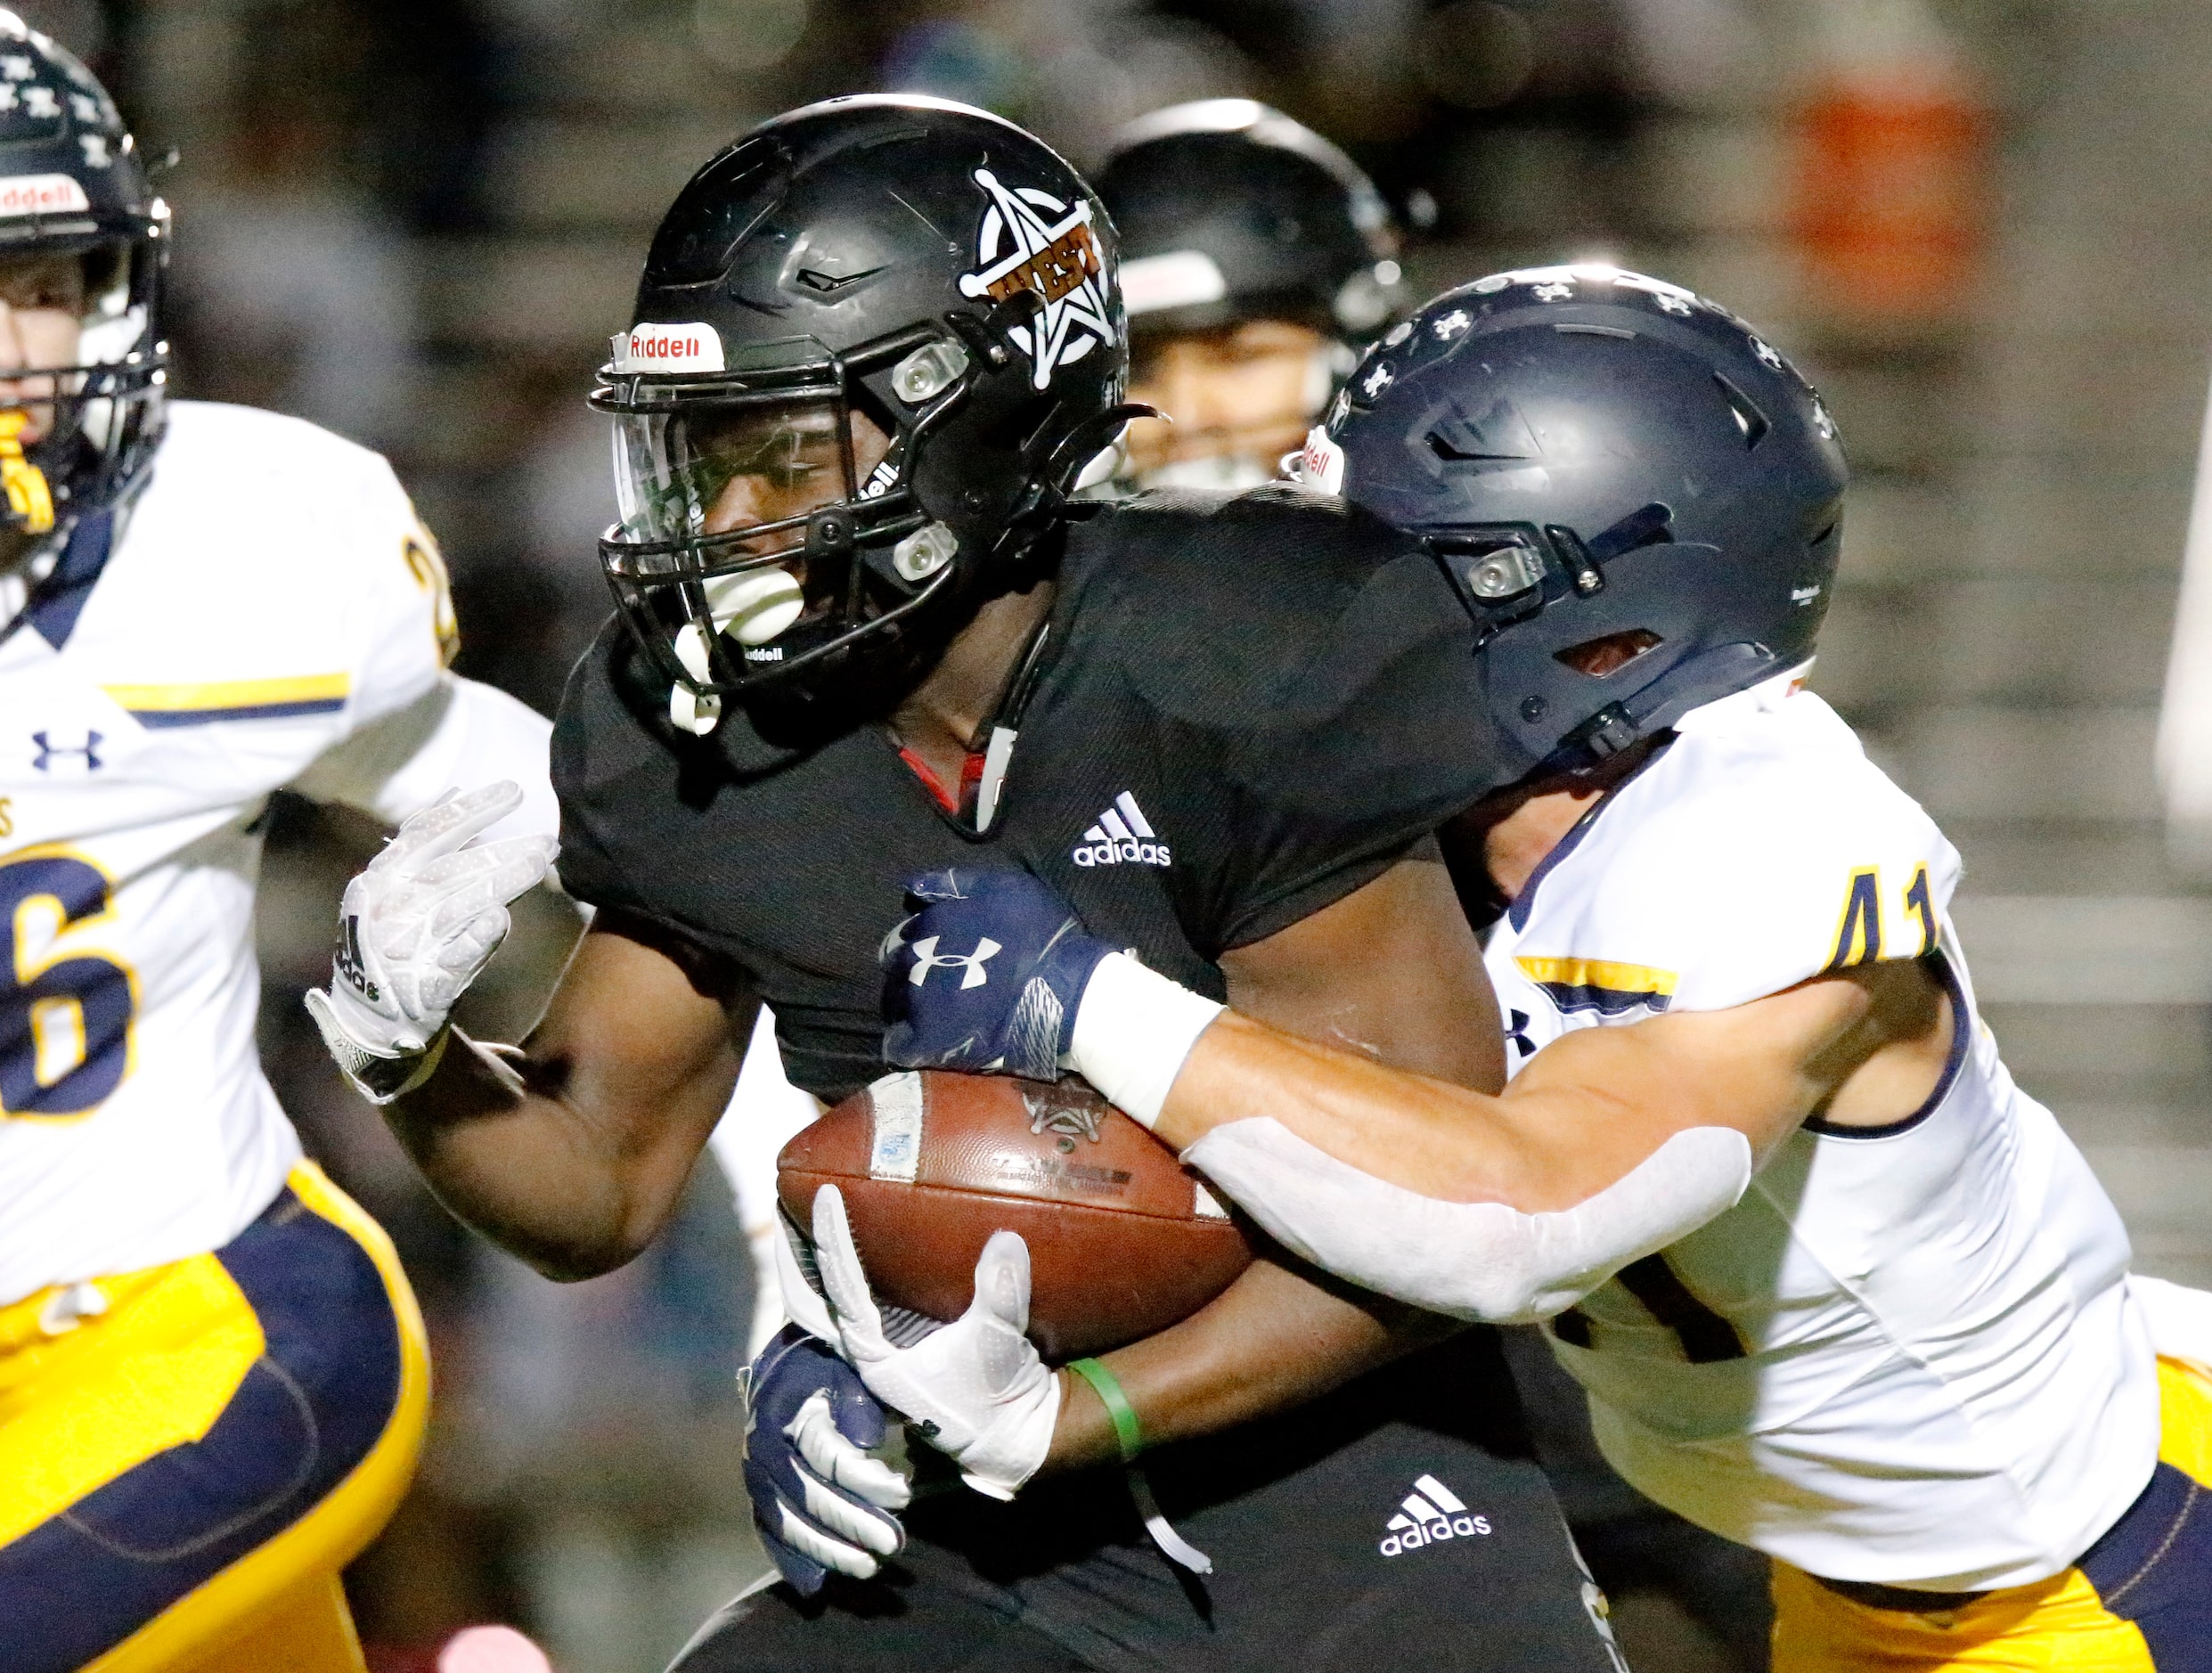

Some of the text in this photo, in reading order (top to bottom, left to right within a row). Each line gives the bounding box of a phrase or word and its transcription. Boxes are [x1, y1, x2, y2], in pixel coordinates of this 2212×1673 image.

[630, 334, 700, 358] Riddell
[1073, 836, 1172, 867] adidas
[0, 839, 141, 1126] 6
[1379, 1514, 1492, 1557] adidas
